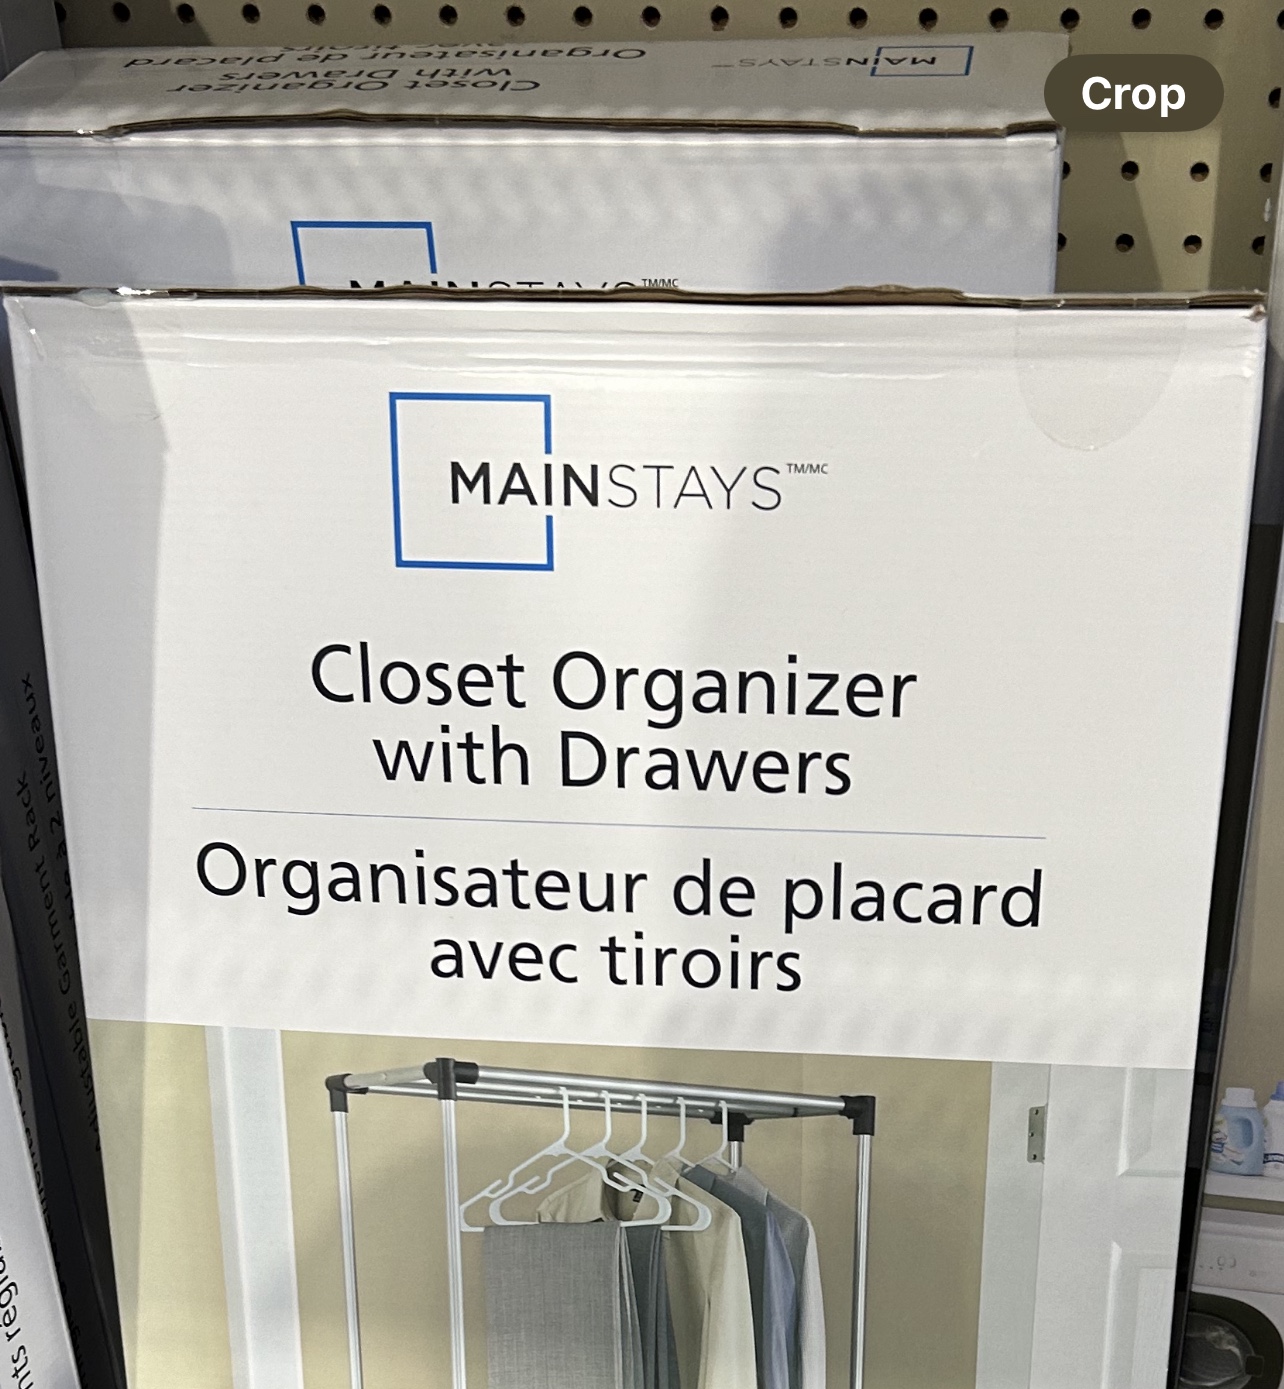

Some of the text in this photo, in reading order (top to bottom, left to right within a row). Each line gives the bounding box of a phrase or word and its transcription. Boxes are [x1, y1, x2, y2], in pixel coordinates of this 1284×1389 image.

[123, 46, 647, 68] Organisateur de placard
[166, 79, 541, 93] Closet Organizer
[219, 68, 512, 80] with Drawers
[738, 56, 936, 68] MAINSTAYS
[450, 460, 783, 511] MAINSTAYS
[311, 641, 918, 729] Closet Organizer
[22, 672, 56, 802] niveaux
[372, 724, 852, 796] with Drawers
[17, 771, 40, 851] Rack
[196, 841, 1042, 934] Organisateur de placard
[35, 856, 71, 995] Garment
[430, 932, 802, 992] avec tiroirs
